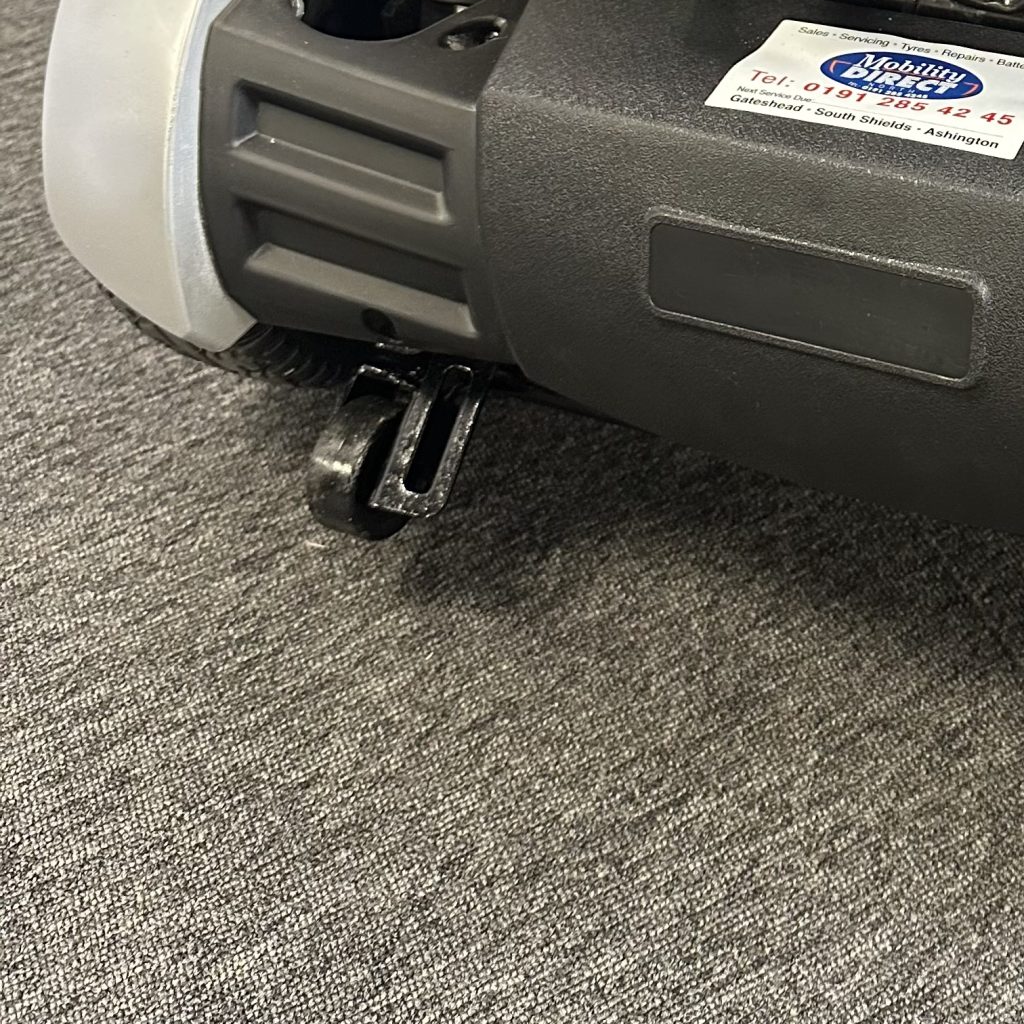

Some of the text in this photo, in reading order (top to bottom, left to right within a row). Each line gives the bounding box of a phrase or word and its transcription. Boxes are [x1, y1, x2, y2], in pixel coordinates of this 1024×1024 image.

[798, 26, 829, 37] Sales
[839, 32, 889, 48] Servicing
[901, 42, 932, 55] Tyres
[941, 48, 986, 63] Repairs
[841, 66, 958, 94] DIRECT
[856, 54, 966, 83] Mobility
[737, 86, 758, 94] Next
[758, 89, 792, 101] Service
[750, 69, 1016, 126] Tel: 0191 285 42 45
[730, 94, 1000, 150] Gateshead South Shields Ashington
